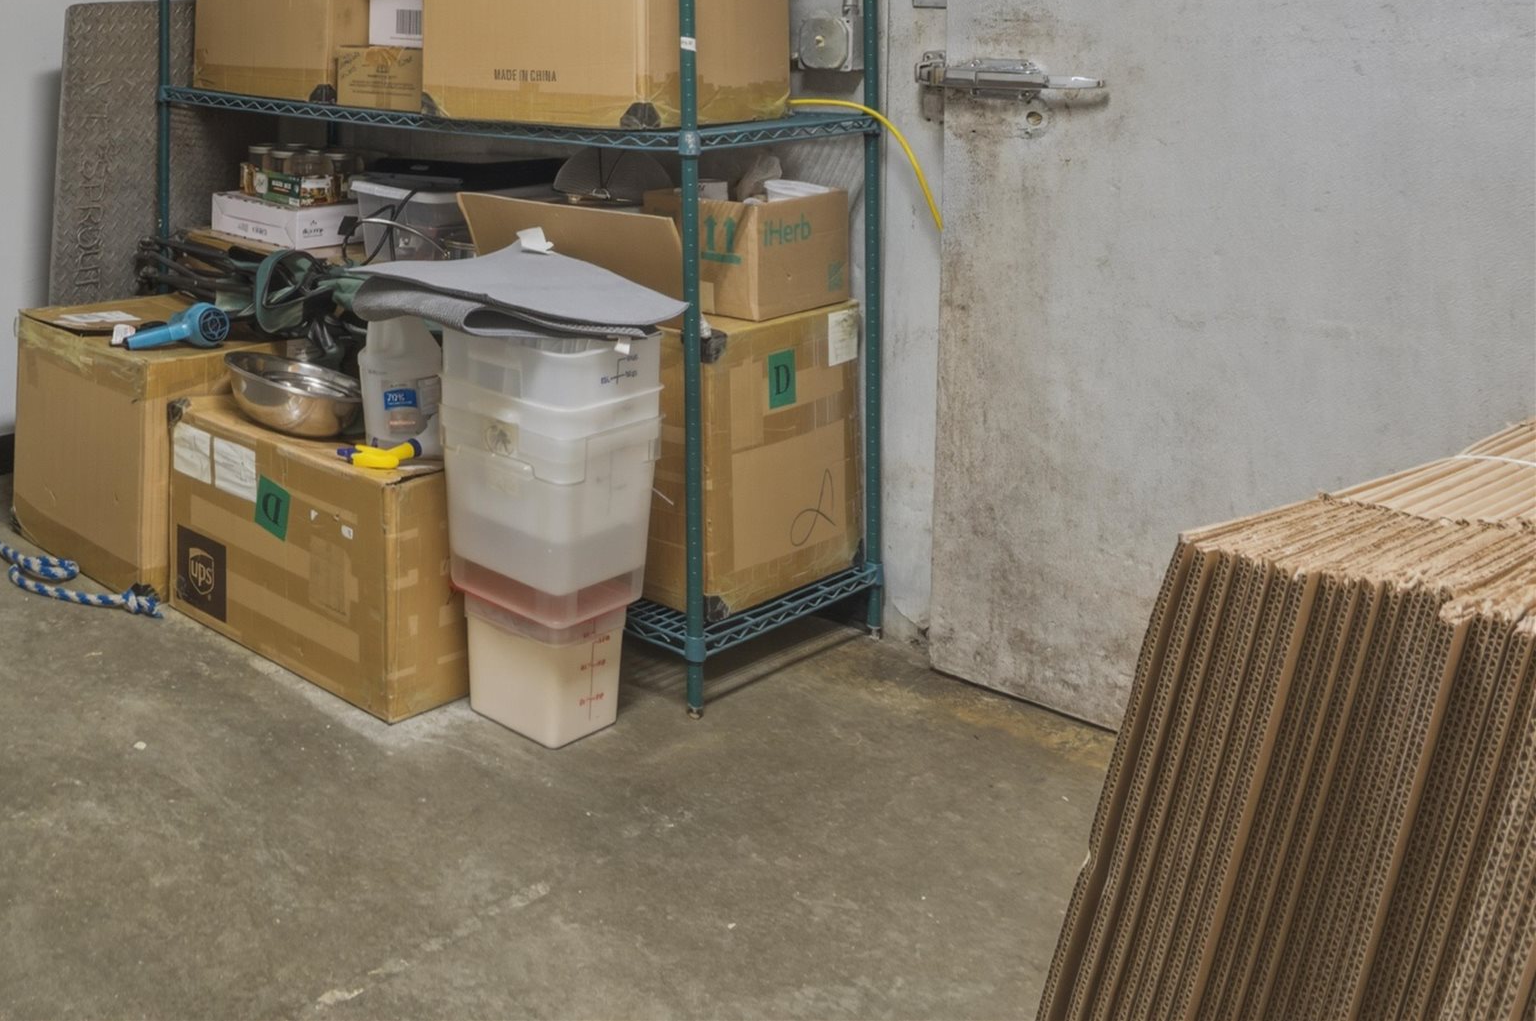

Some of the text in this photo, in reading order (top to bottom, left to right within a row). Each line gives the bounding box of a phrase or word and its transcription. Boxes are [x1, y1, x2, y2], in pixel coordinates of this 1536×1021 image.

[493, 69, 557, 82] MADE IN CHINA
[763, 211, 812, 247] iHerb
[774, 364, 791, 396] D
[191, 560, 213, 587] ups
